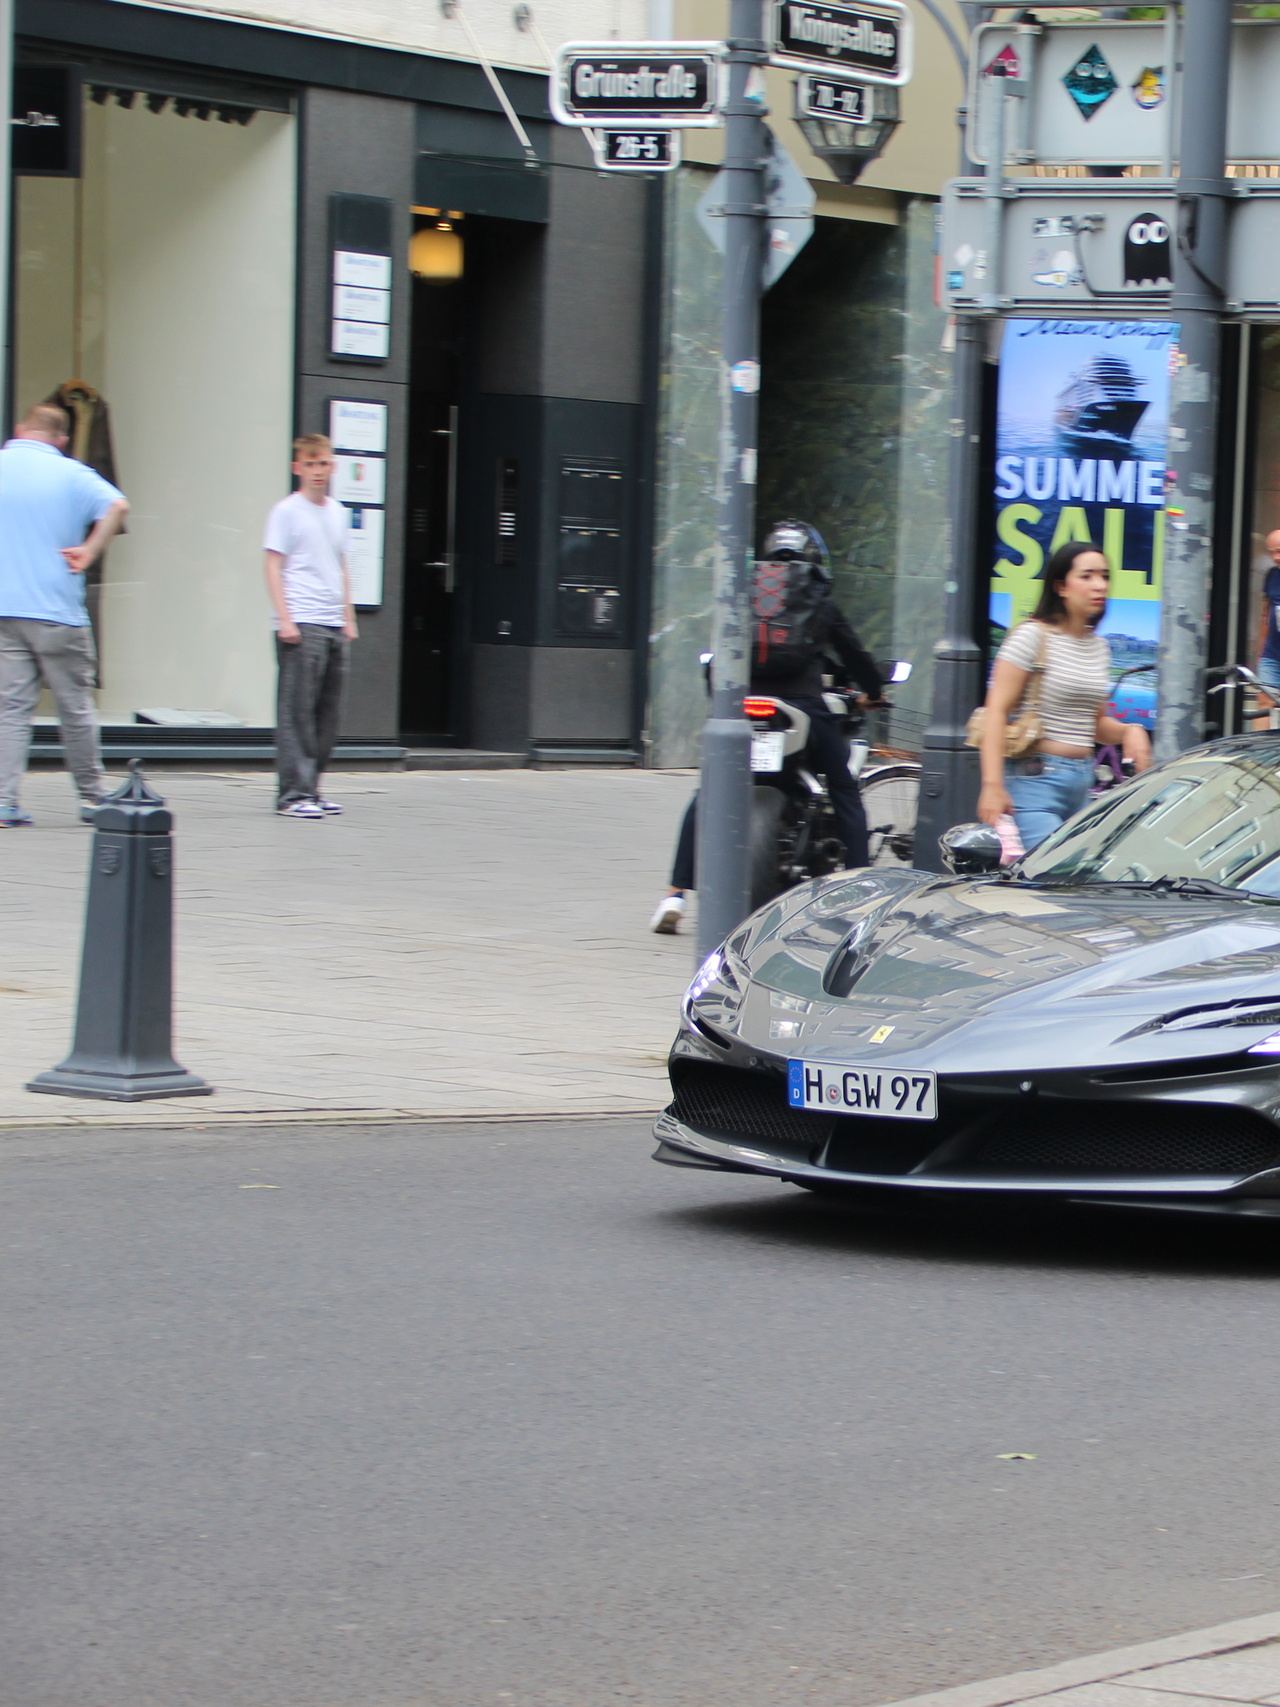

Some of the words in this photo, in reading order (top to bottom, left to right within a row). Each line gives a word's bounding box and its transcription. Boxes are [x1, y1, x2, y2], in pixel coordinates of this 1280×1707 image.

[789, 5, 896, 57] Königsallee
[575, 64, 697, 98] Grünstraße
[615, 136, 659, 158] 26-5
[993, 455, 1166, 505] SUMME
[793, 1088, 800, 1099] D
[805, 1067, 823, 1104] H
[842, 1071, 882, 1109] GW
[891, 1075, 931, 1112] 97
